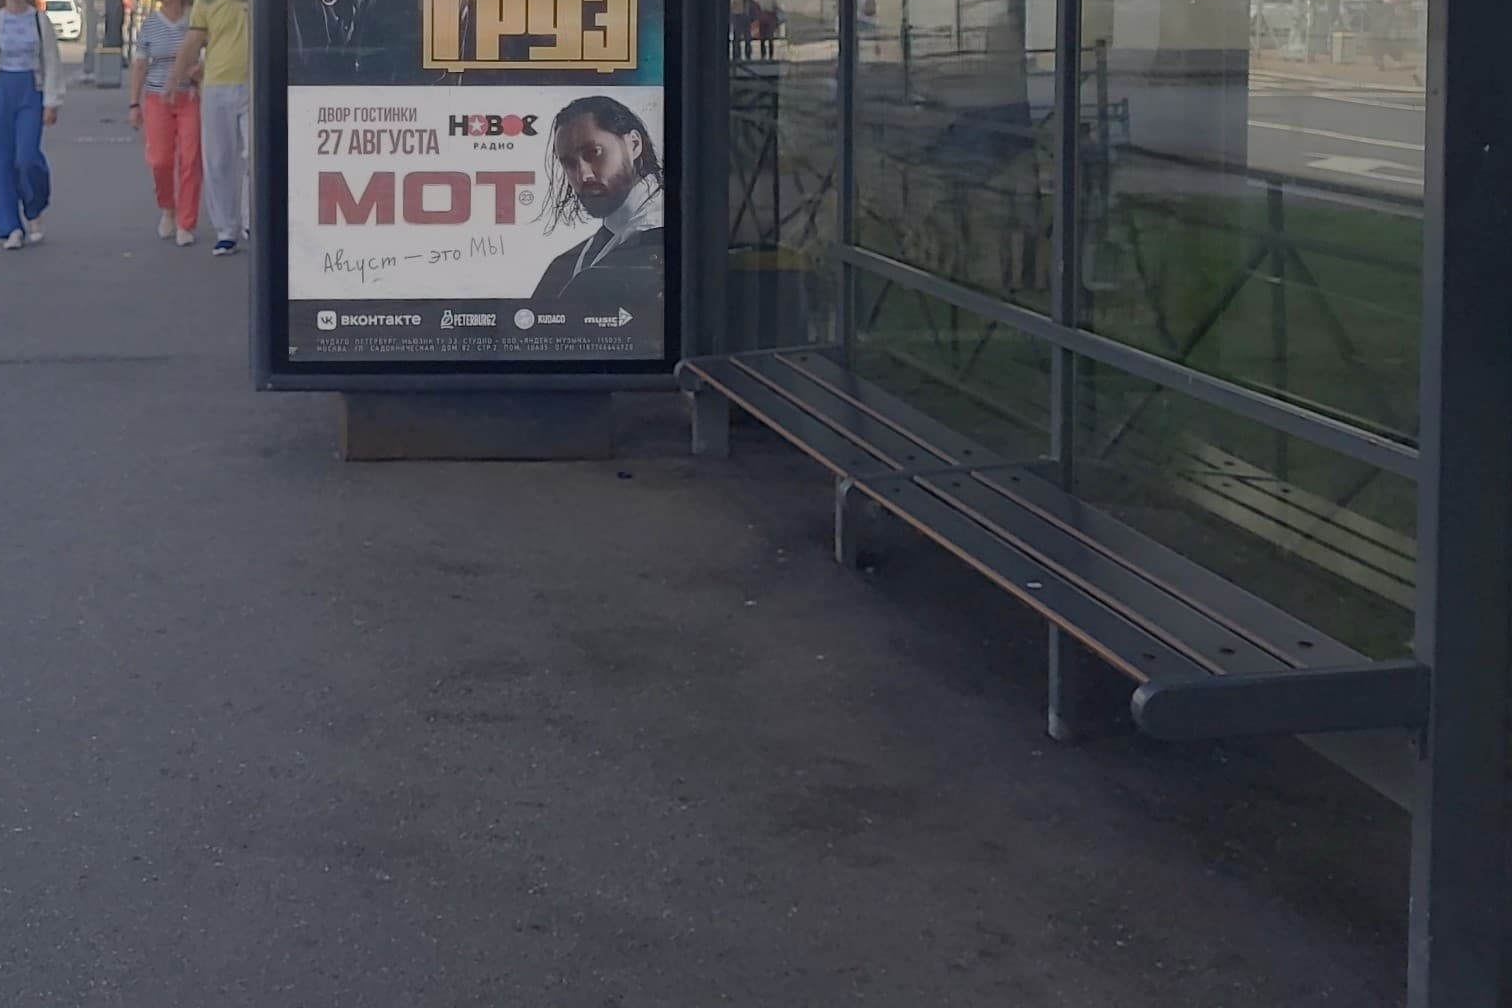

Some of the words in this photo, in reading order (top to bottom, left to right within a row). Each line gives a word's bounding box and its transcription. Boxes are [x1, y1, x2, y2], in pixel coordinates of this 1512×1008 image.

[317, 107, 351, 124] ДВОР
[354, 106, 417, 123] ГОСТИНКИ
[317, 129, 344, 155] 27
[348, 129, 440, 155] АВГУСТА
[473, 142, 514, 150] РАДИО
[317, 171, 536, 225] МОТ
[323, 249, 397, 284] Август
[428, 249, 462, 264] это
